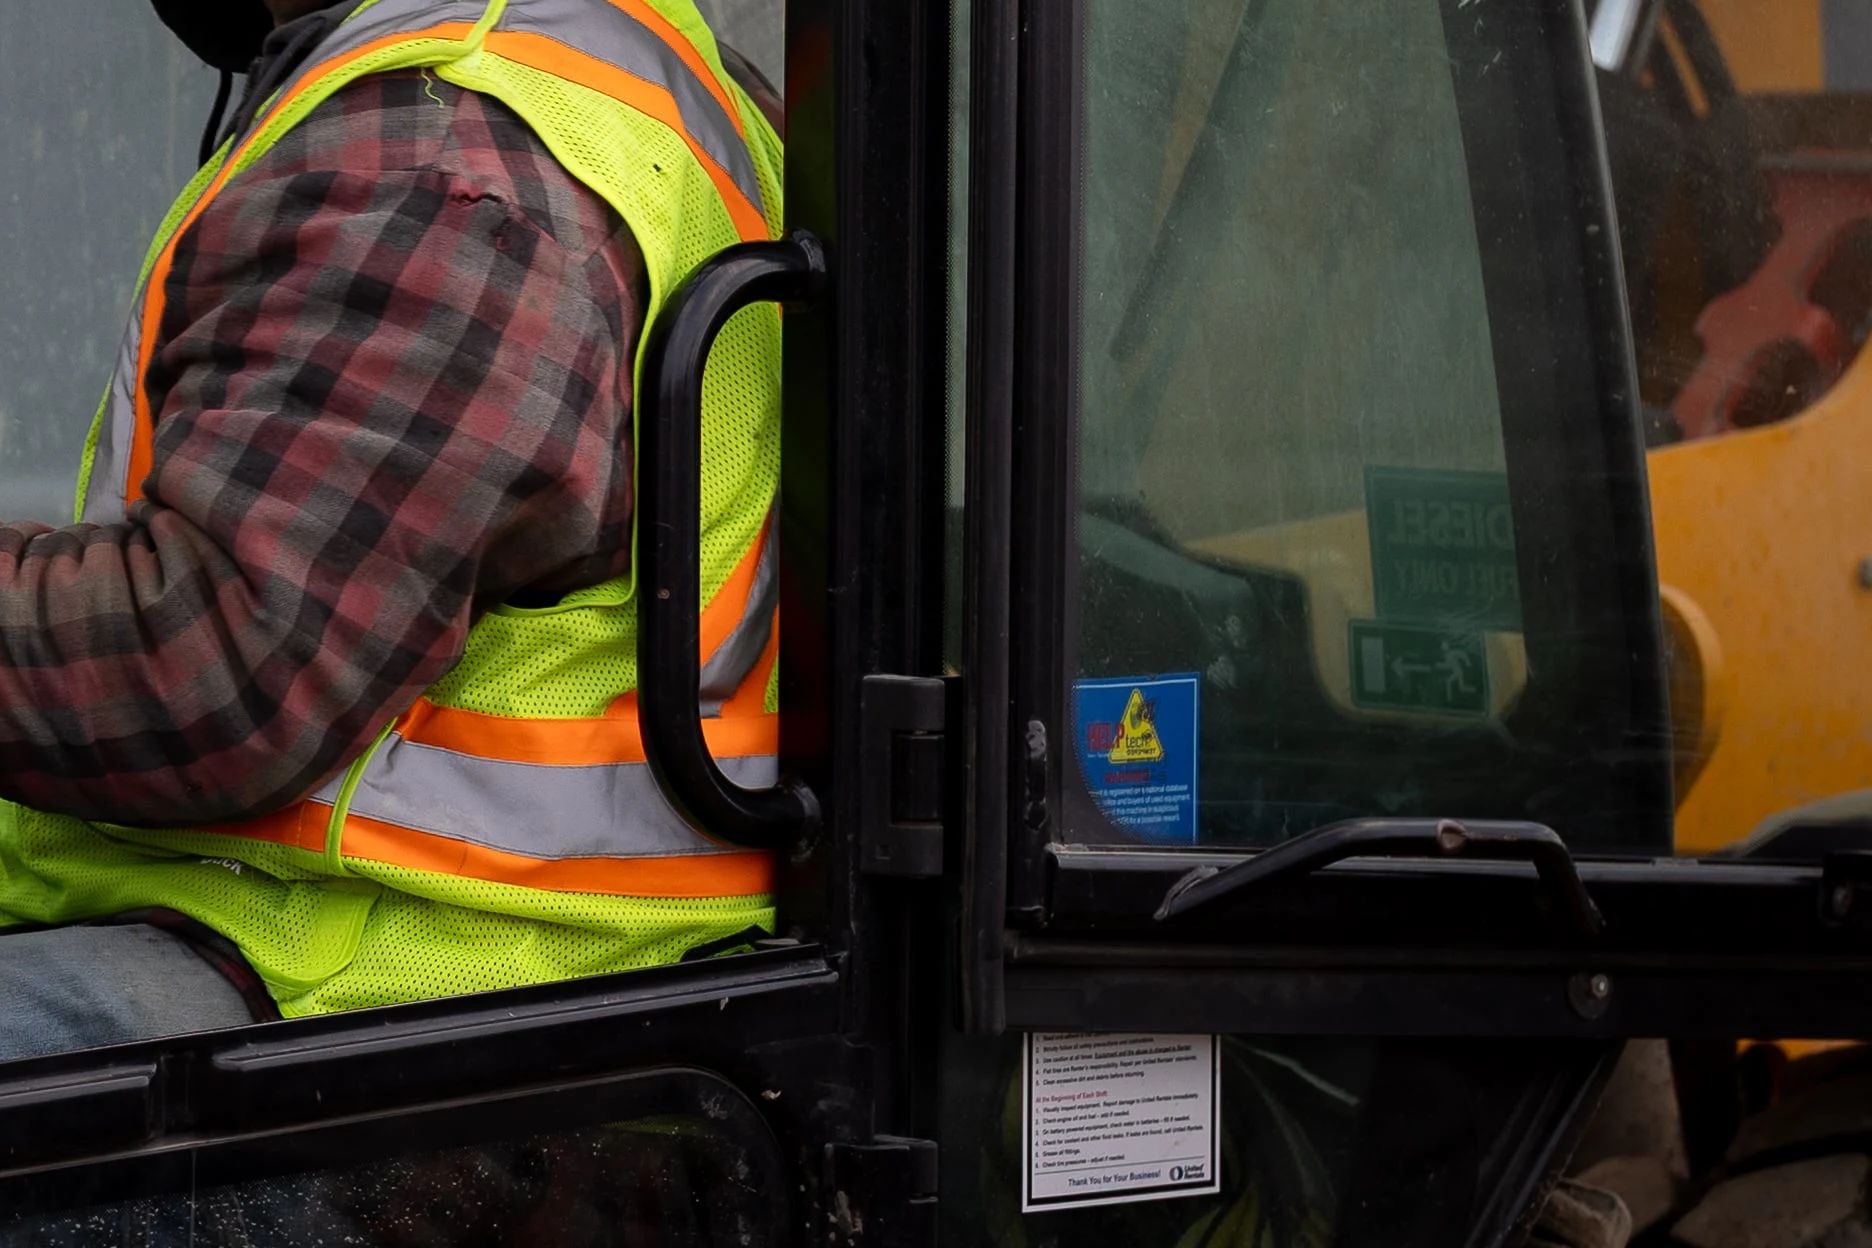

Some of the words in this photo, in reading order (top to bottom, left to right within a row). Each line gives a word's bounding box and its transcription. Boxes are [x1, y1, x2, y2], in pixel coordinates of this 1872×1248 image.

[1069, 1177, 1088, 1187] Thank
[1089, 1176, 1101, 1185] You
[1103, 1175, 1112, 1183] for
[1114, 1173, 1128, 1182] Your
